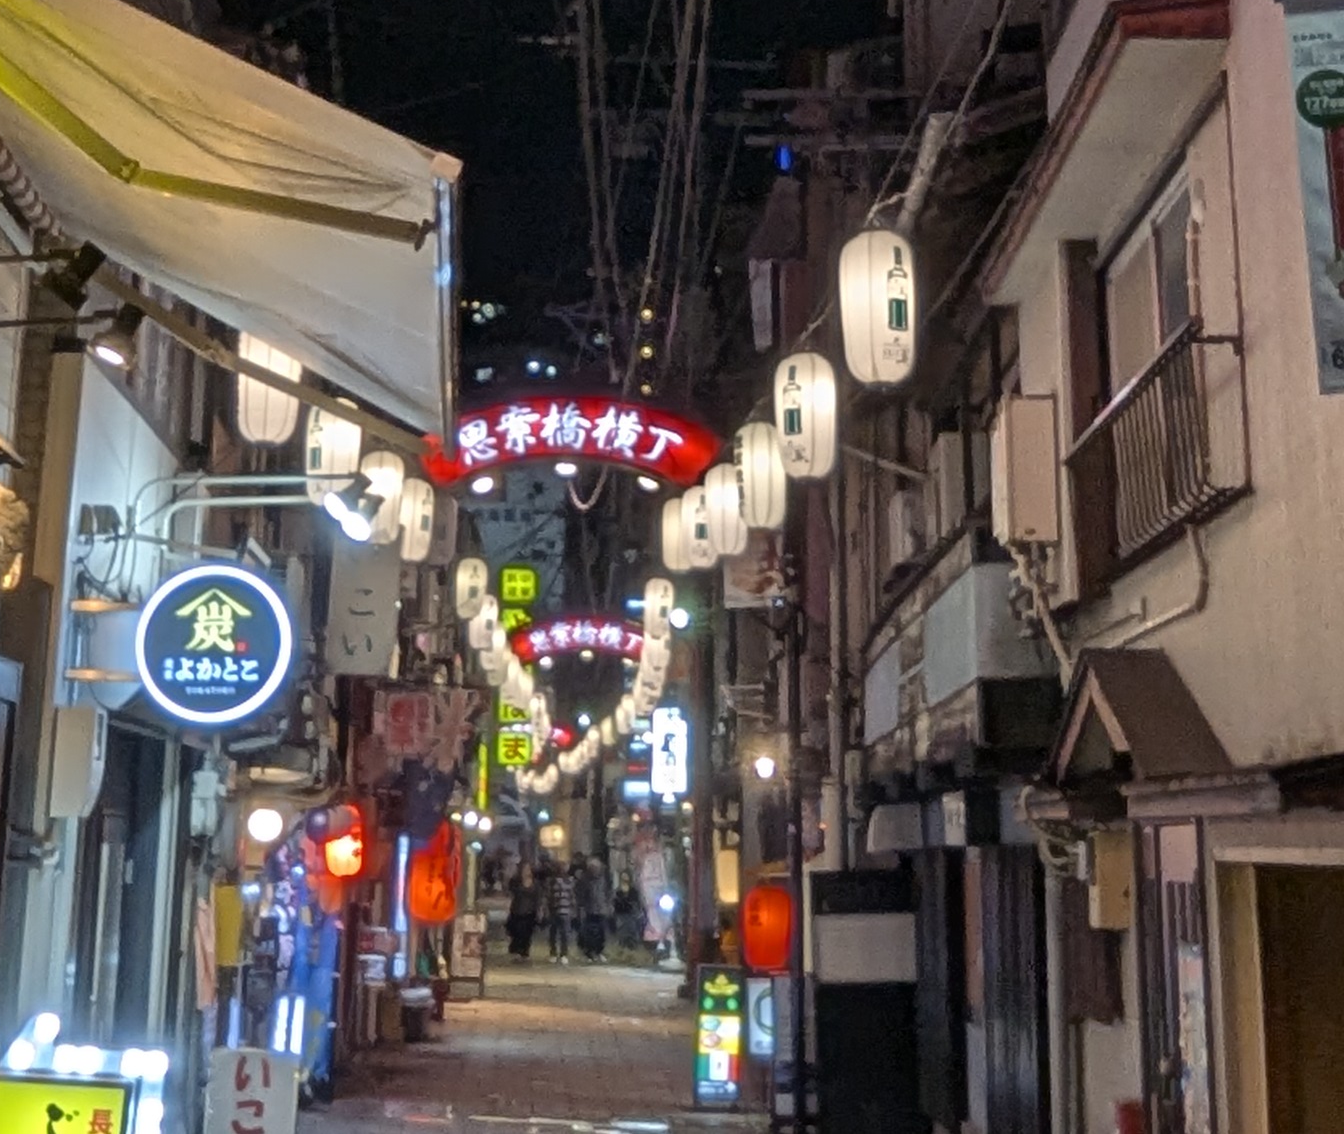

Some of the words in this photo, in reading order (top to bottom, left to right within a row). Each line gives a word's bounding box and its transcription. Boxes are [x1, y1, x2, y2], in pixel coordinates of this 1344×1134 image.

[458, 402, 684, 466] 思案橋横丁
[184, 600, 236, 652] 炭
